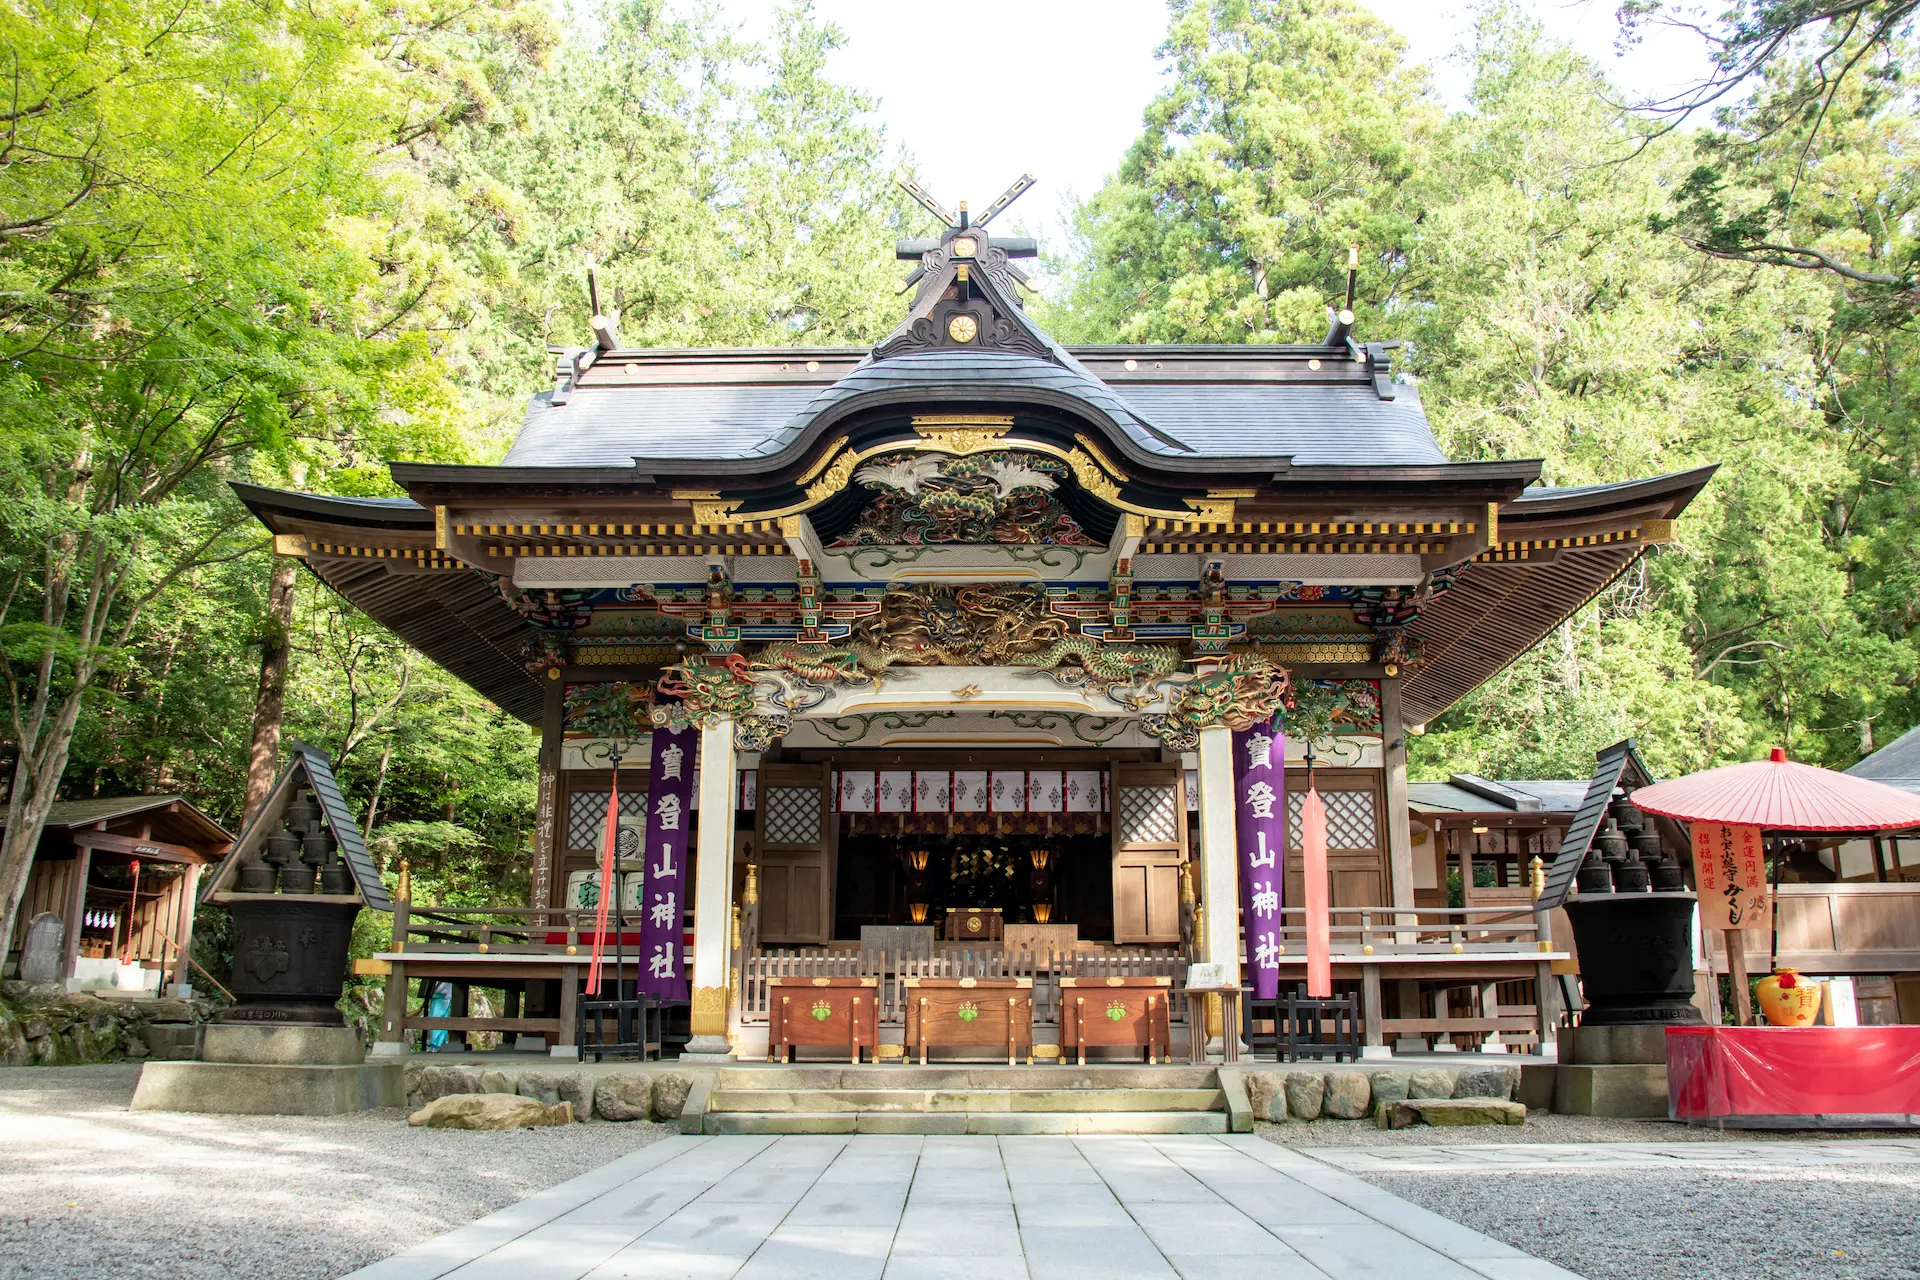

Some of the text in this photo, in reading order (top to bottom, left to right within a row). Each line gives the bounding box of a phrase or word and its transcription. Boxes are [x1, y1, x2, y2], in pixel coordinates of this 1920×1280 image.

[1698, 832, 1716, 890] 招福開運
[1741, 830, 1760, 889] 金運円満
